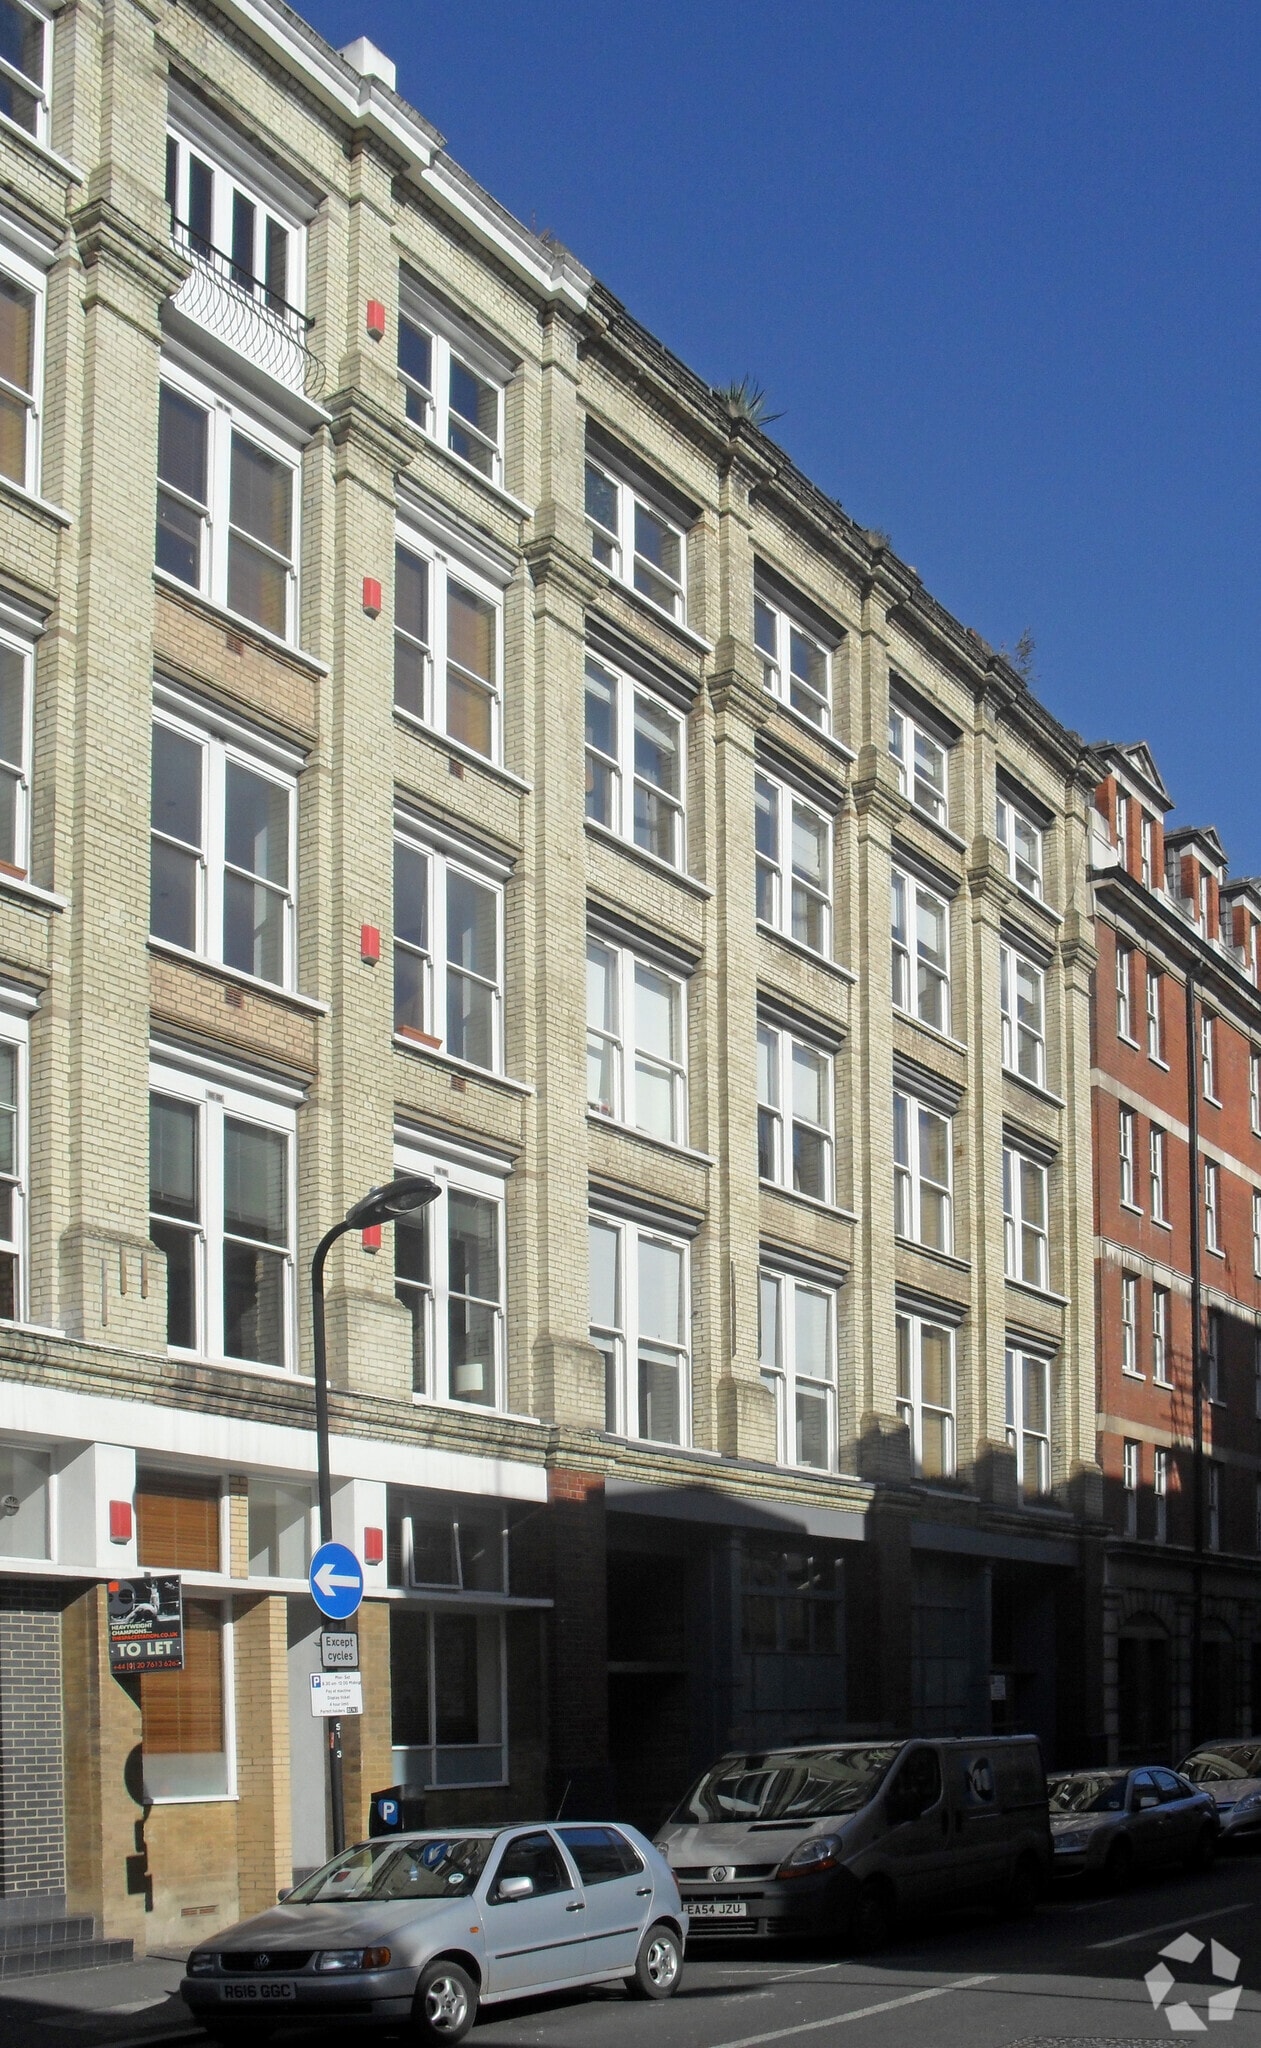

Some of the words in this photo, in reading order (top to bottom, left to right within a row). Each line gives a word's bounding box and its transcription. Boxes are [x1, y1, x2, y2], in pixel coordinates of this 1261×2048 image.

[111, 1622, 153, 1631] HEAVYWEIGHT
[325, 1636, 354, 1648] Except
[117, 1642, 141, 1657] TO
[146, 1640, 173, 1655] LET
[327, 1650, 354, 1663] cycles
[137, 1661, 145, 1669] 20
[146, 1660, 163, 1668] 7613
[335, 1722, 341, 1731] S
[336, 1750, 342, 1759] 3
[383, 1801, 395, 1821] P
[687, 1904, 715, 1915] EA54
[718, 1904, 741, 1914] JZU
[224, 1984, 257, 1999] R616
[260, 1984, 291, 1998] GGC
